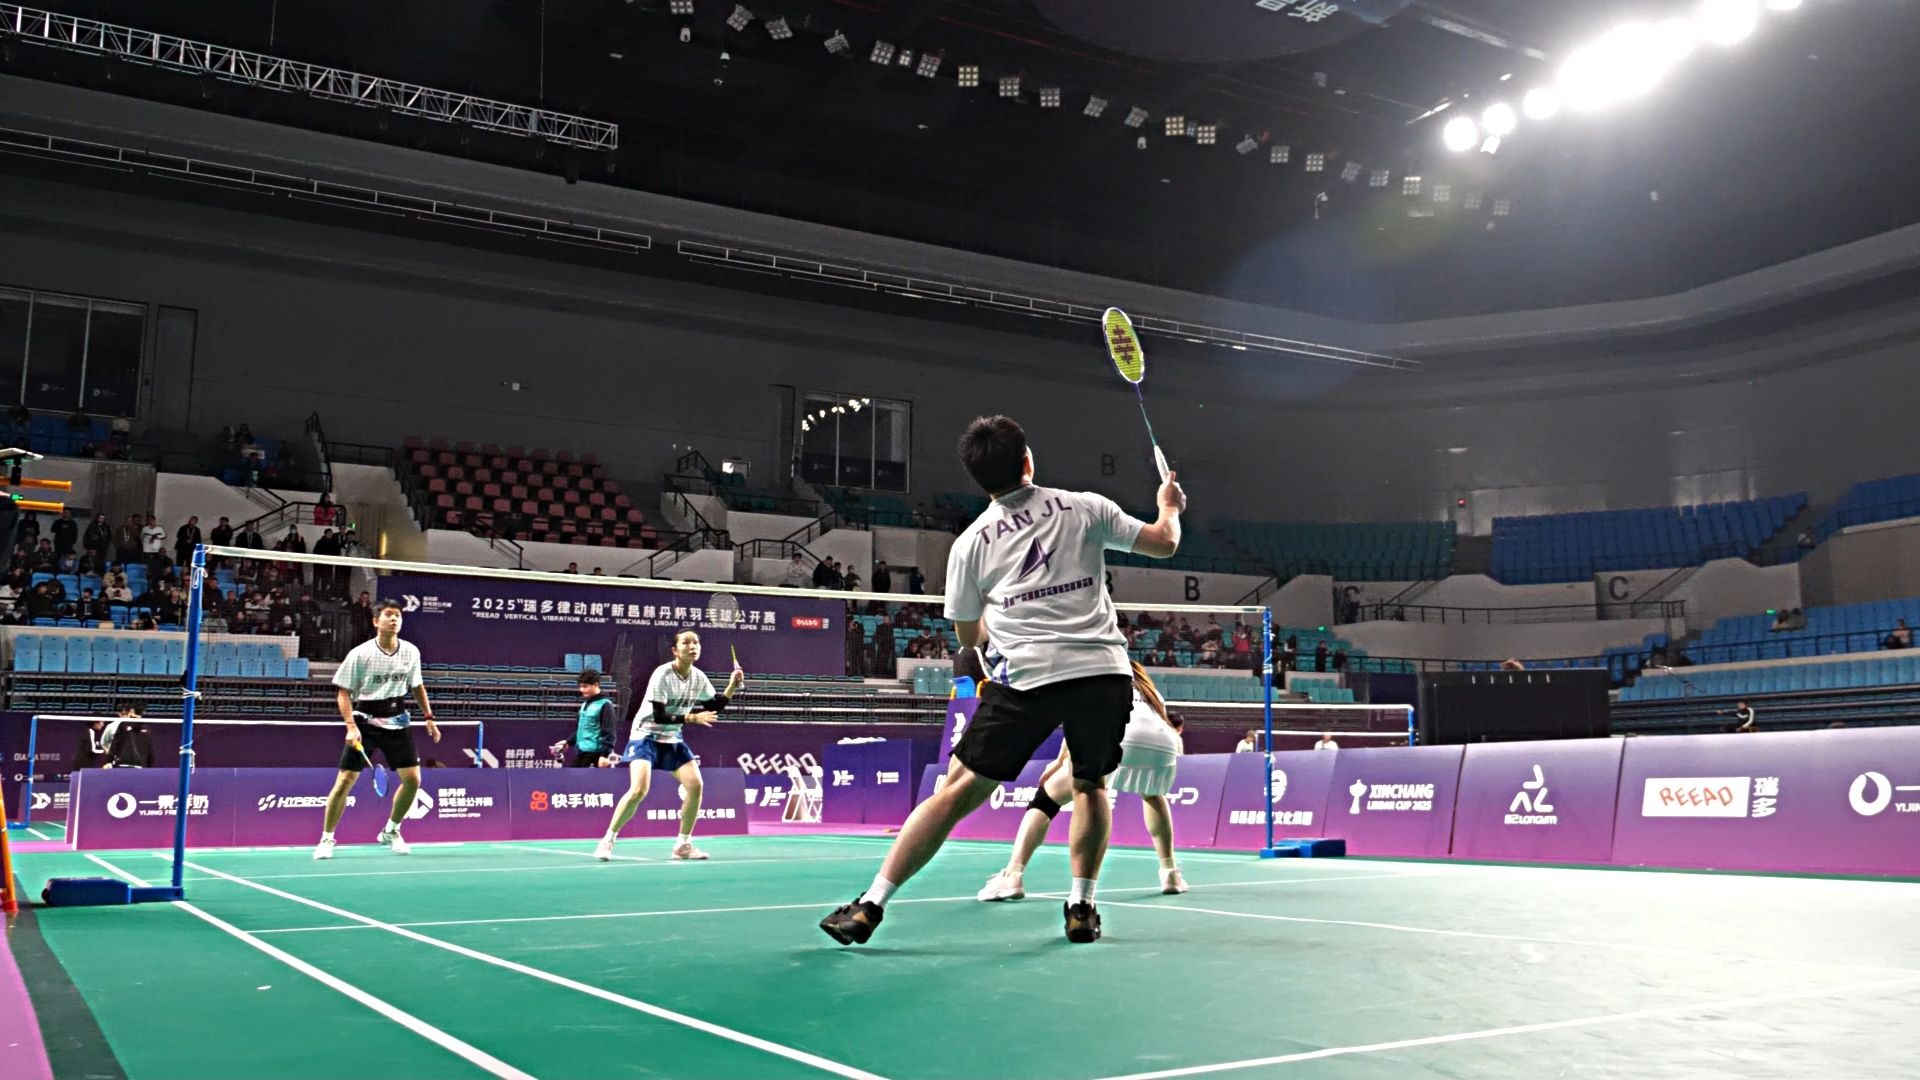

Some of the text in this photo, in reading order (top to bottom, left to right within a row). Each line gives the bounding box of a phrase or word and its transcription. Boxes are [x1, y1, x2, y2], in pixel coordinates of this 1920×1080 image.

[976, 496, 1072, 545] TAN JL
[1184, 575, 1200, 601] B
[1608, 576, 1629, 601] C
[504, 613, 538, 621] VERTICAL
[615, 618, 651, 626] XINCHANG
[737, 752, 817, 775] REEAD
[551, 793, 614, 808] 快手体育
[1369, 784, 1434, 799] XINCHANG
[1659, 786, 1733, 807] REEAD
